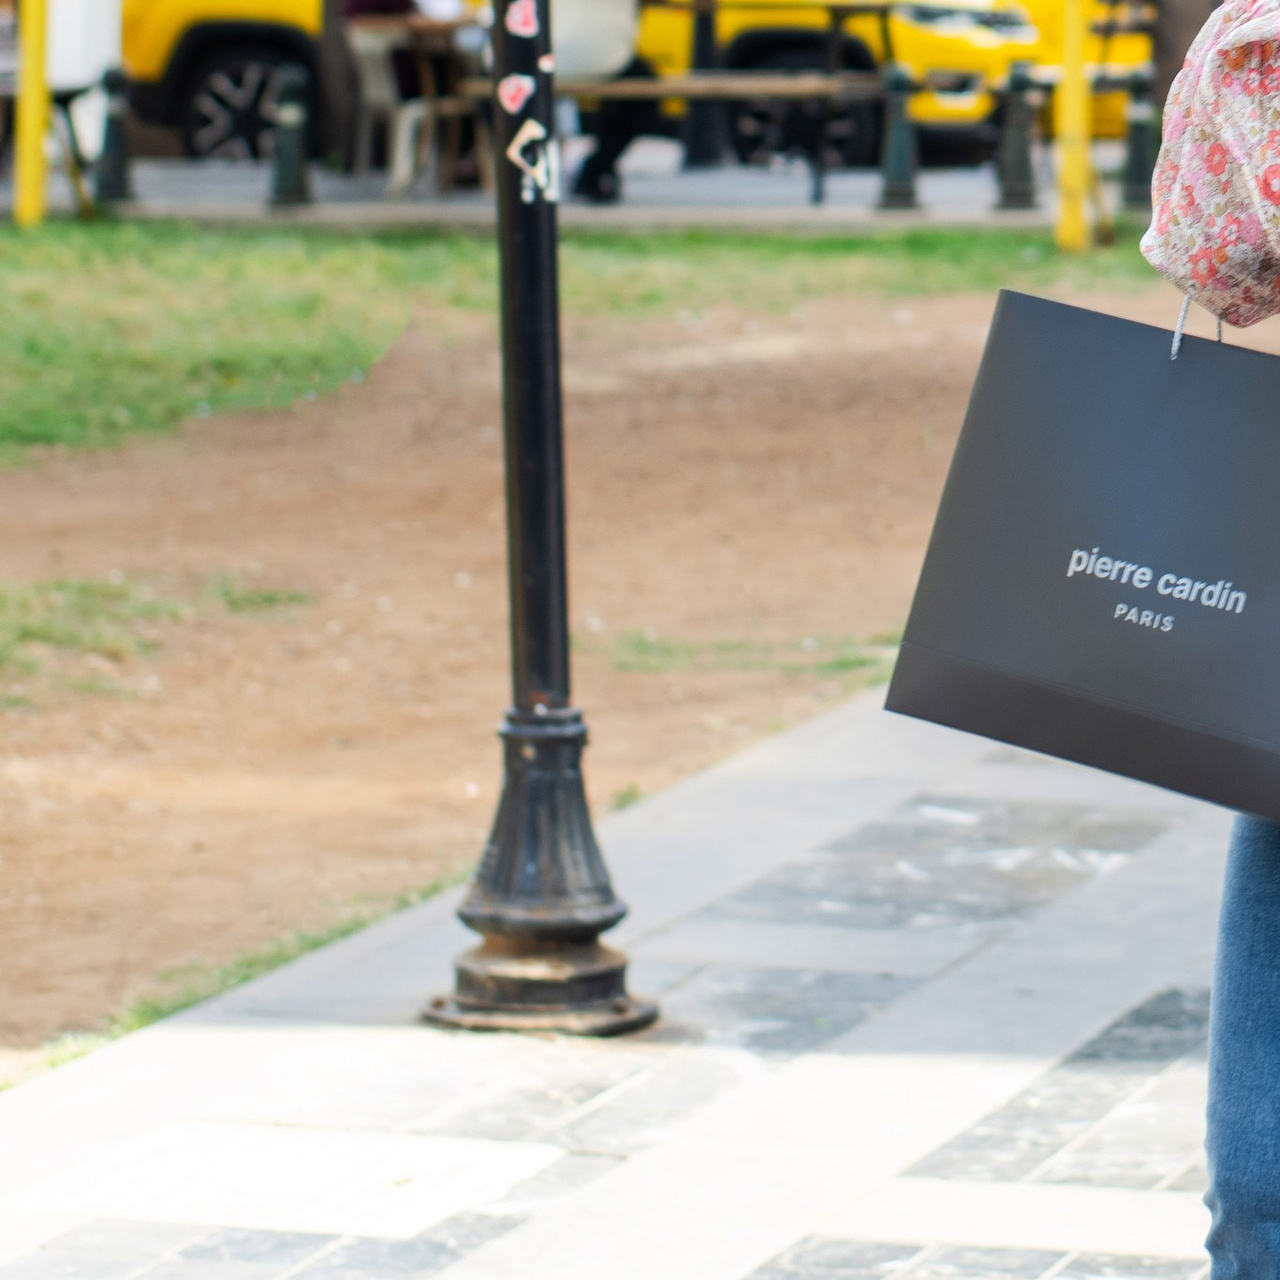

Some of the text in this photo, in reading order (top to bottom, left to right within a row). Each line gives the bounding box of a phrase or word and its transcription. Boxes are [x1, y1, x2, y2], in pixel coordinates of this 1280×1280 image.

[1066, 547, 1248, 614] pierre cardin
[1113, 603, 1176, 632] PARIS
